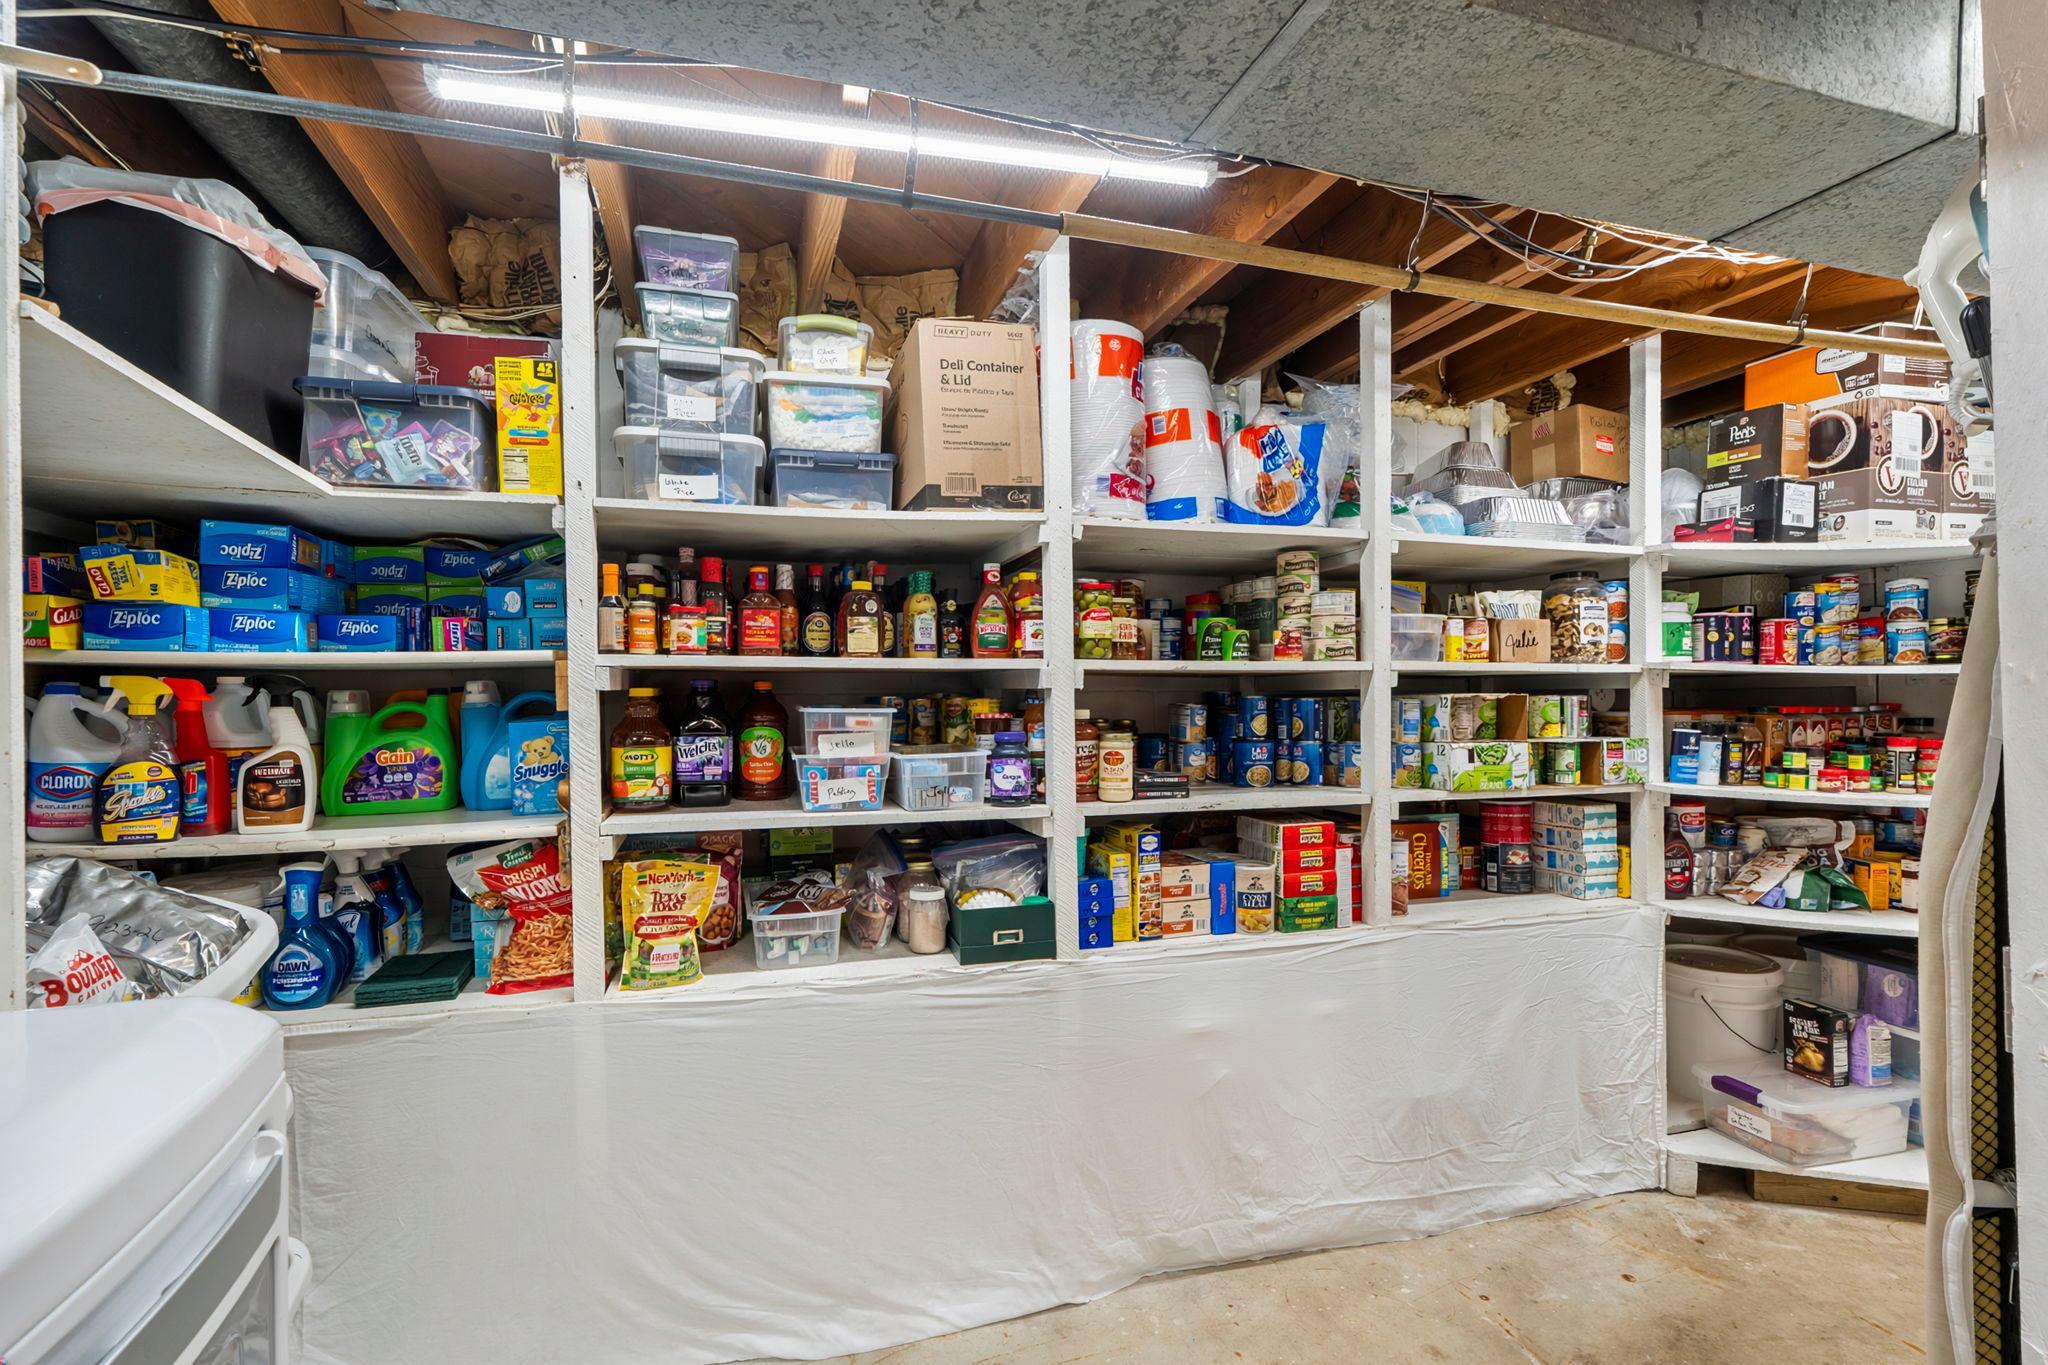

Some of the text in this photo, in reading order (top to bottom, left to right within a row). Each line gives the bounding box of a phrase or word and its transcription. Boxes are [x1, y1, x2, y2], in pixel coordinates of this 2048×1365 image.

[937, 328, 965, 336] HEAVY
[536, 362, 554, 373] 42
[939, 359, 1025, 374] Deli Container
[940, 374, 971, 386] & Lid
[219, 544, 263, 561] Ziploc
[443, 553, 476, 566] Ziploc
[225, 571, 268, 587] Ziploc
[370, 566, 405, 579] Ziploc
[53, 608, 83, 625] GLAD
[113, 610, 161, 628] Ziploc
[234, 614, 276, 631] Ziploc
[340, 619, 379, 636] Ziploc
[1504, 630, 1539, 656] Julie
[1439, 696, 1449, 709] 12
[376, 747, 415, 766] Gain
[1436, 744, 1446, 757] 12
[513, 761, 570, 782] Snuggle
[40, 775, 93, 789] CLOROX
[1412, 832, 1427, 890] Cheerios
[502, 863, 548, 886] CRISPY
[278, 960, 311, 973] DAWN
